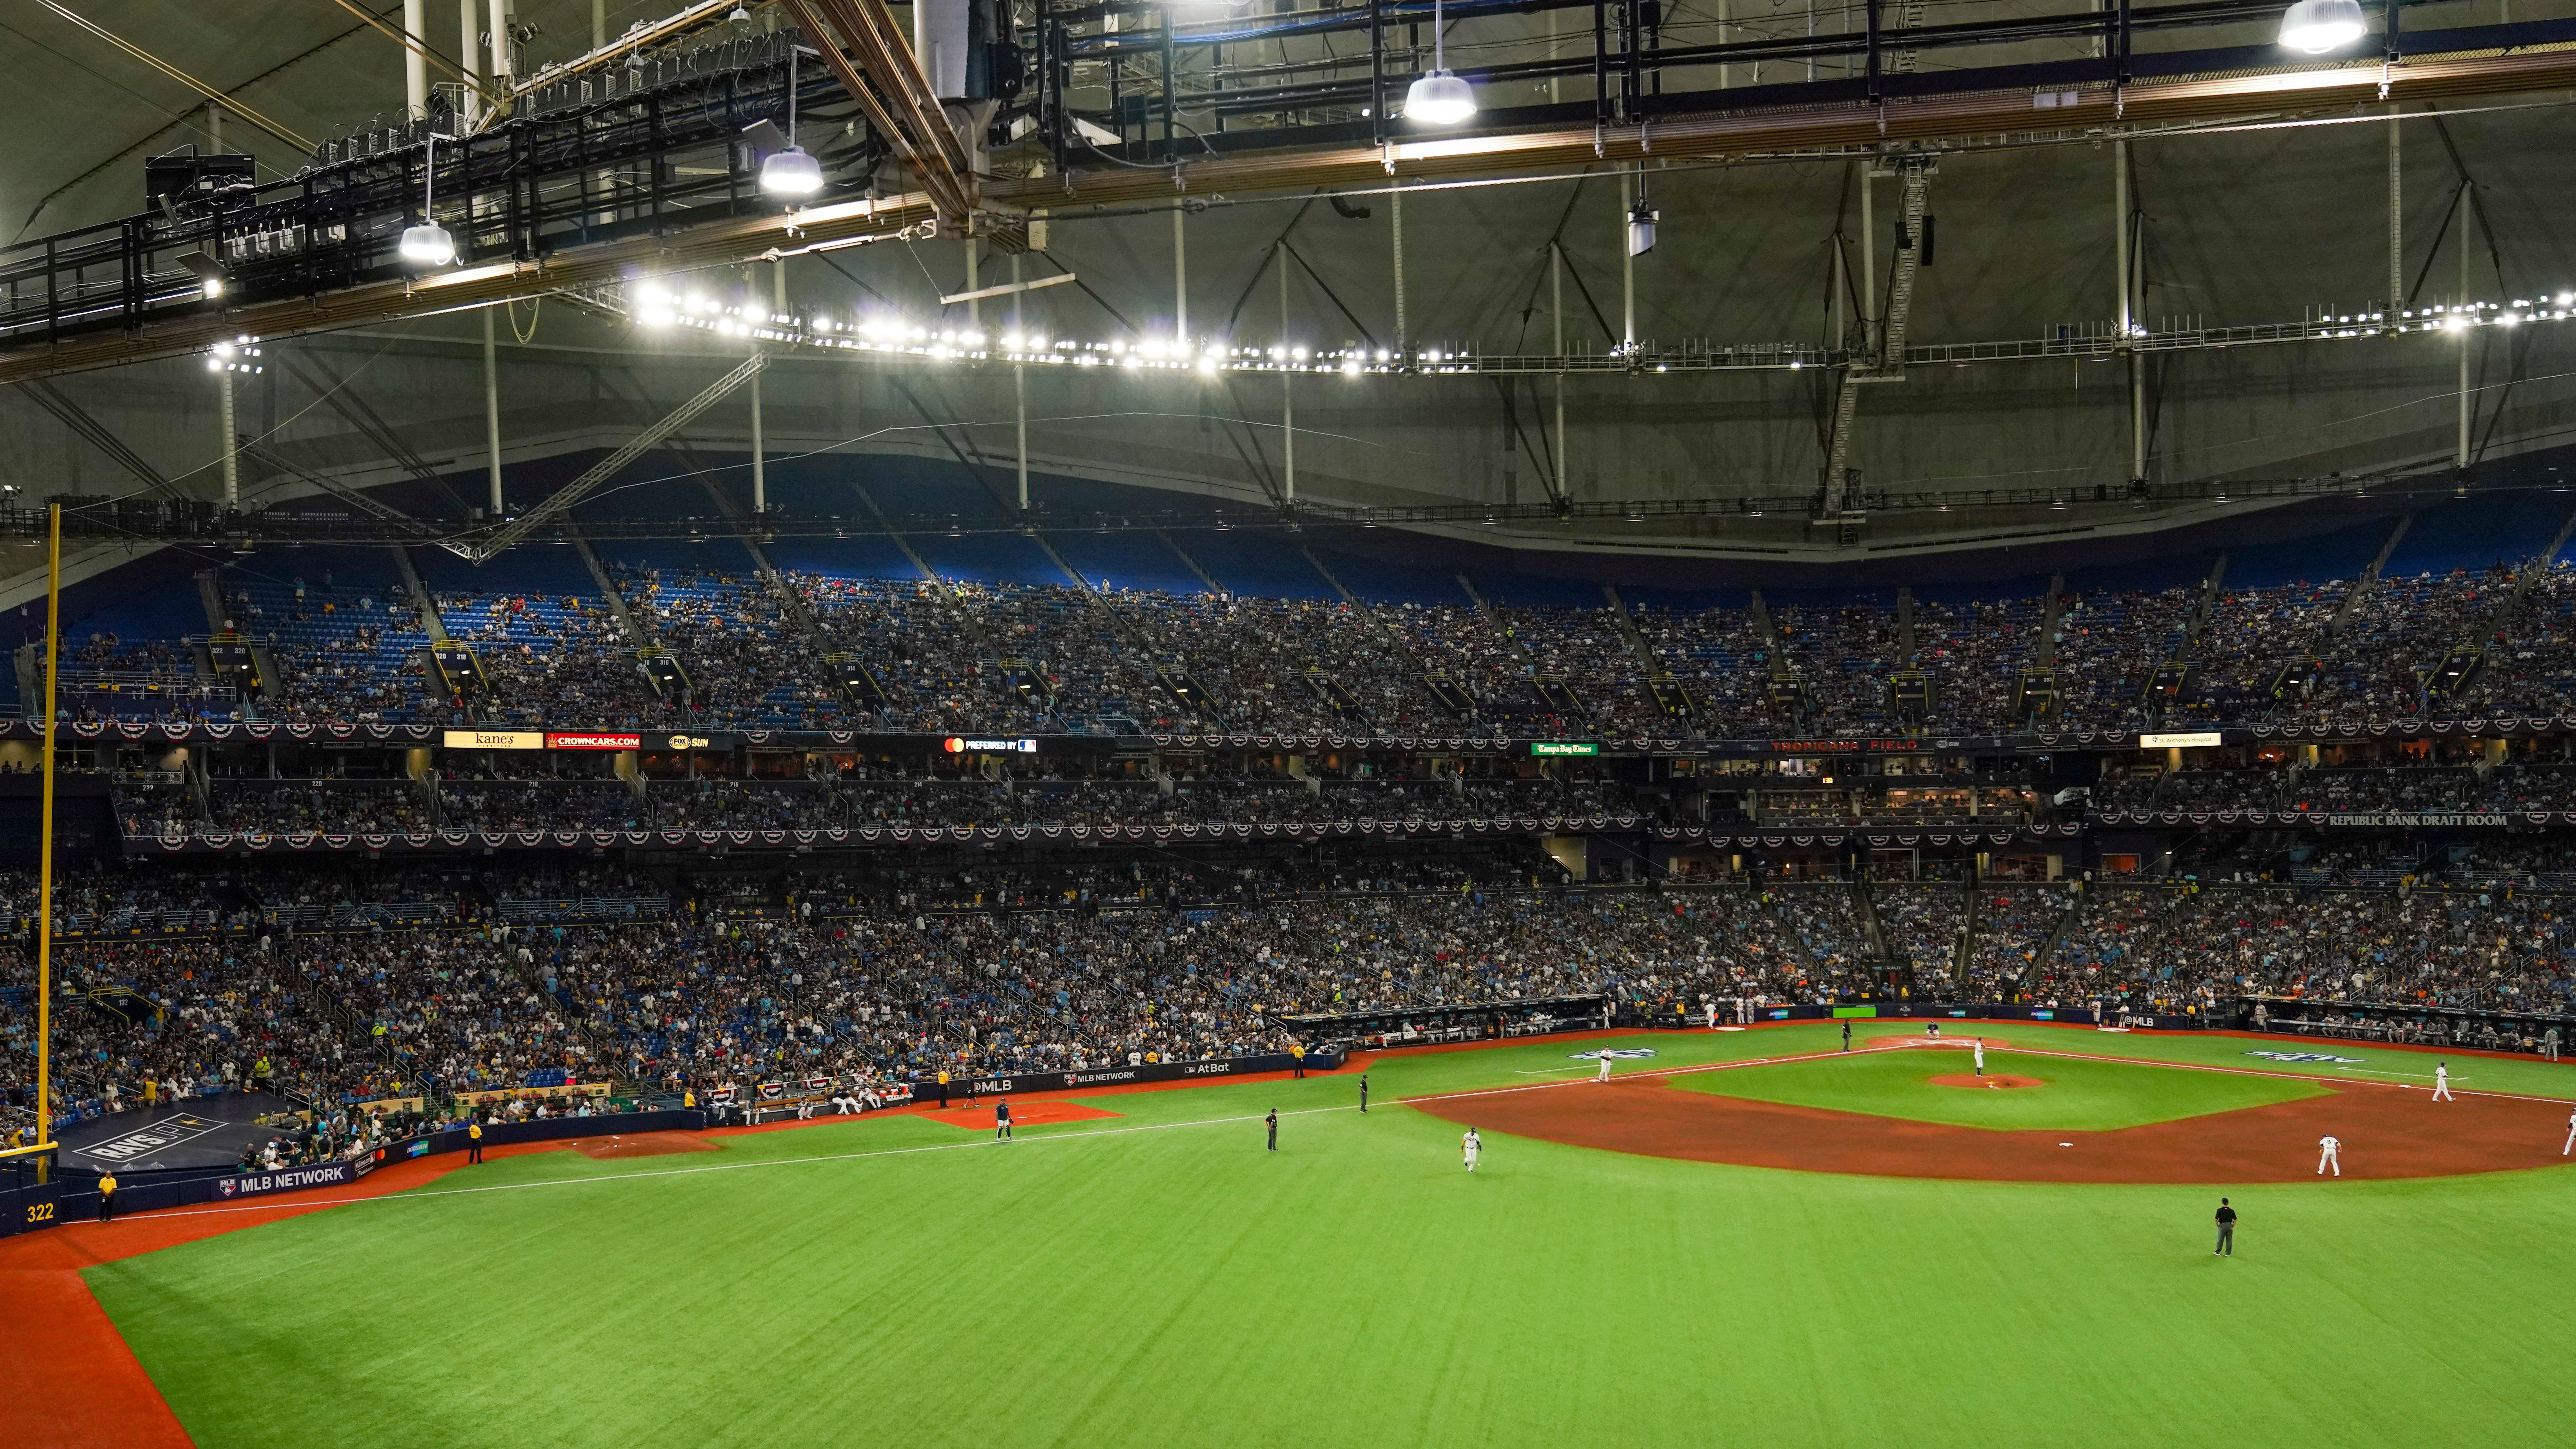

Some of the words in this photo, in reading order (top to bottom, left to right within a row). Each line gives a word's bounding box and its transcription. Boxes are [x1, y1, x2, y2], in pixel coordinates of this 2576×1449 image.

[476, 733, 513, 744] kane's
[558, 738, 639, 746] CROWNCARS.COM
[691, 738, 709, 747] SUN
[966, 741, 1006, 749] PREFERRED
[1007, 742, 1017, 750] BY
[1538, 745, 1559, 755] Tampa
[1560, 745, 1573, 753] Bay
[1772, 742, 1859, 751] TROPICANA
[1870, 740, 1917, 750] FIELD
[2330, 816, 2384, 825] REPUBLIC
[2386, 816, 2420, 825] BANK
[2422, 816, 2464, 825] DRAFT
[2466, 816, 2508, 825] ROOM
[2124, 1015, 2154, 1027] @MLB
[1197, 1064, 1209, 1074] At
[1210, 1063, 1229, 1073] Bat
[1077, 1074, 1094, 1083] MLB
[1096, 1072, 1135, 1081] NETWORK
[89, 1135, 166, 1159] RAYS
[407, 1144, 428, 1153] DOOSAN
[241, 1176, 272, 1193] MLB
[275, 1167, 343, 1188] NETWORK
[28, 1203, 54, 1222] 322
